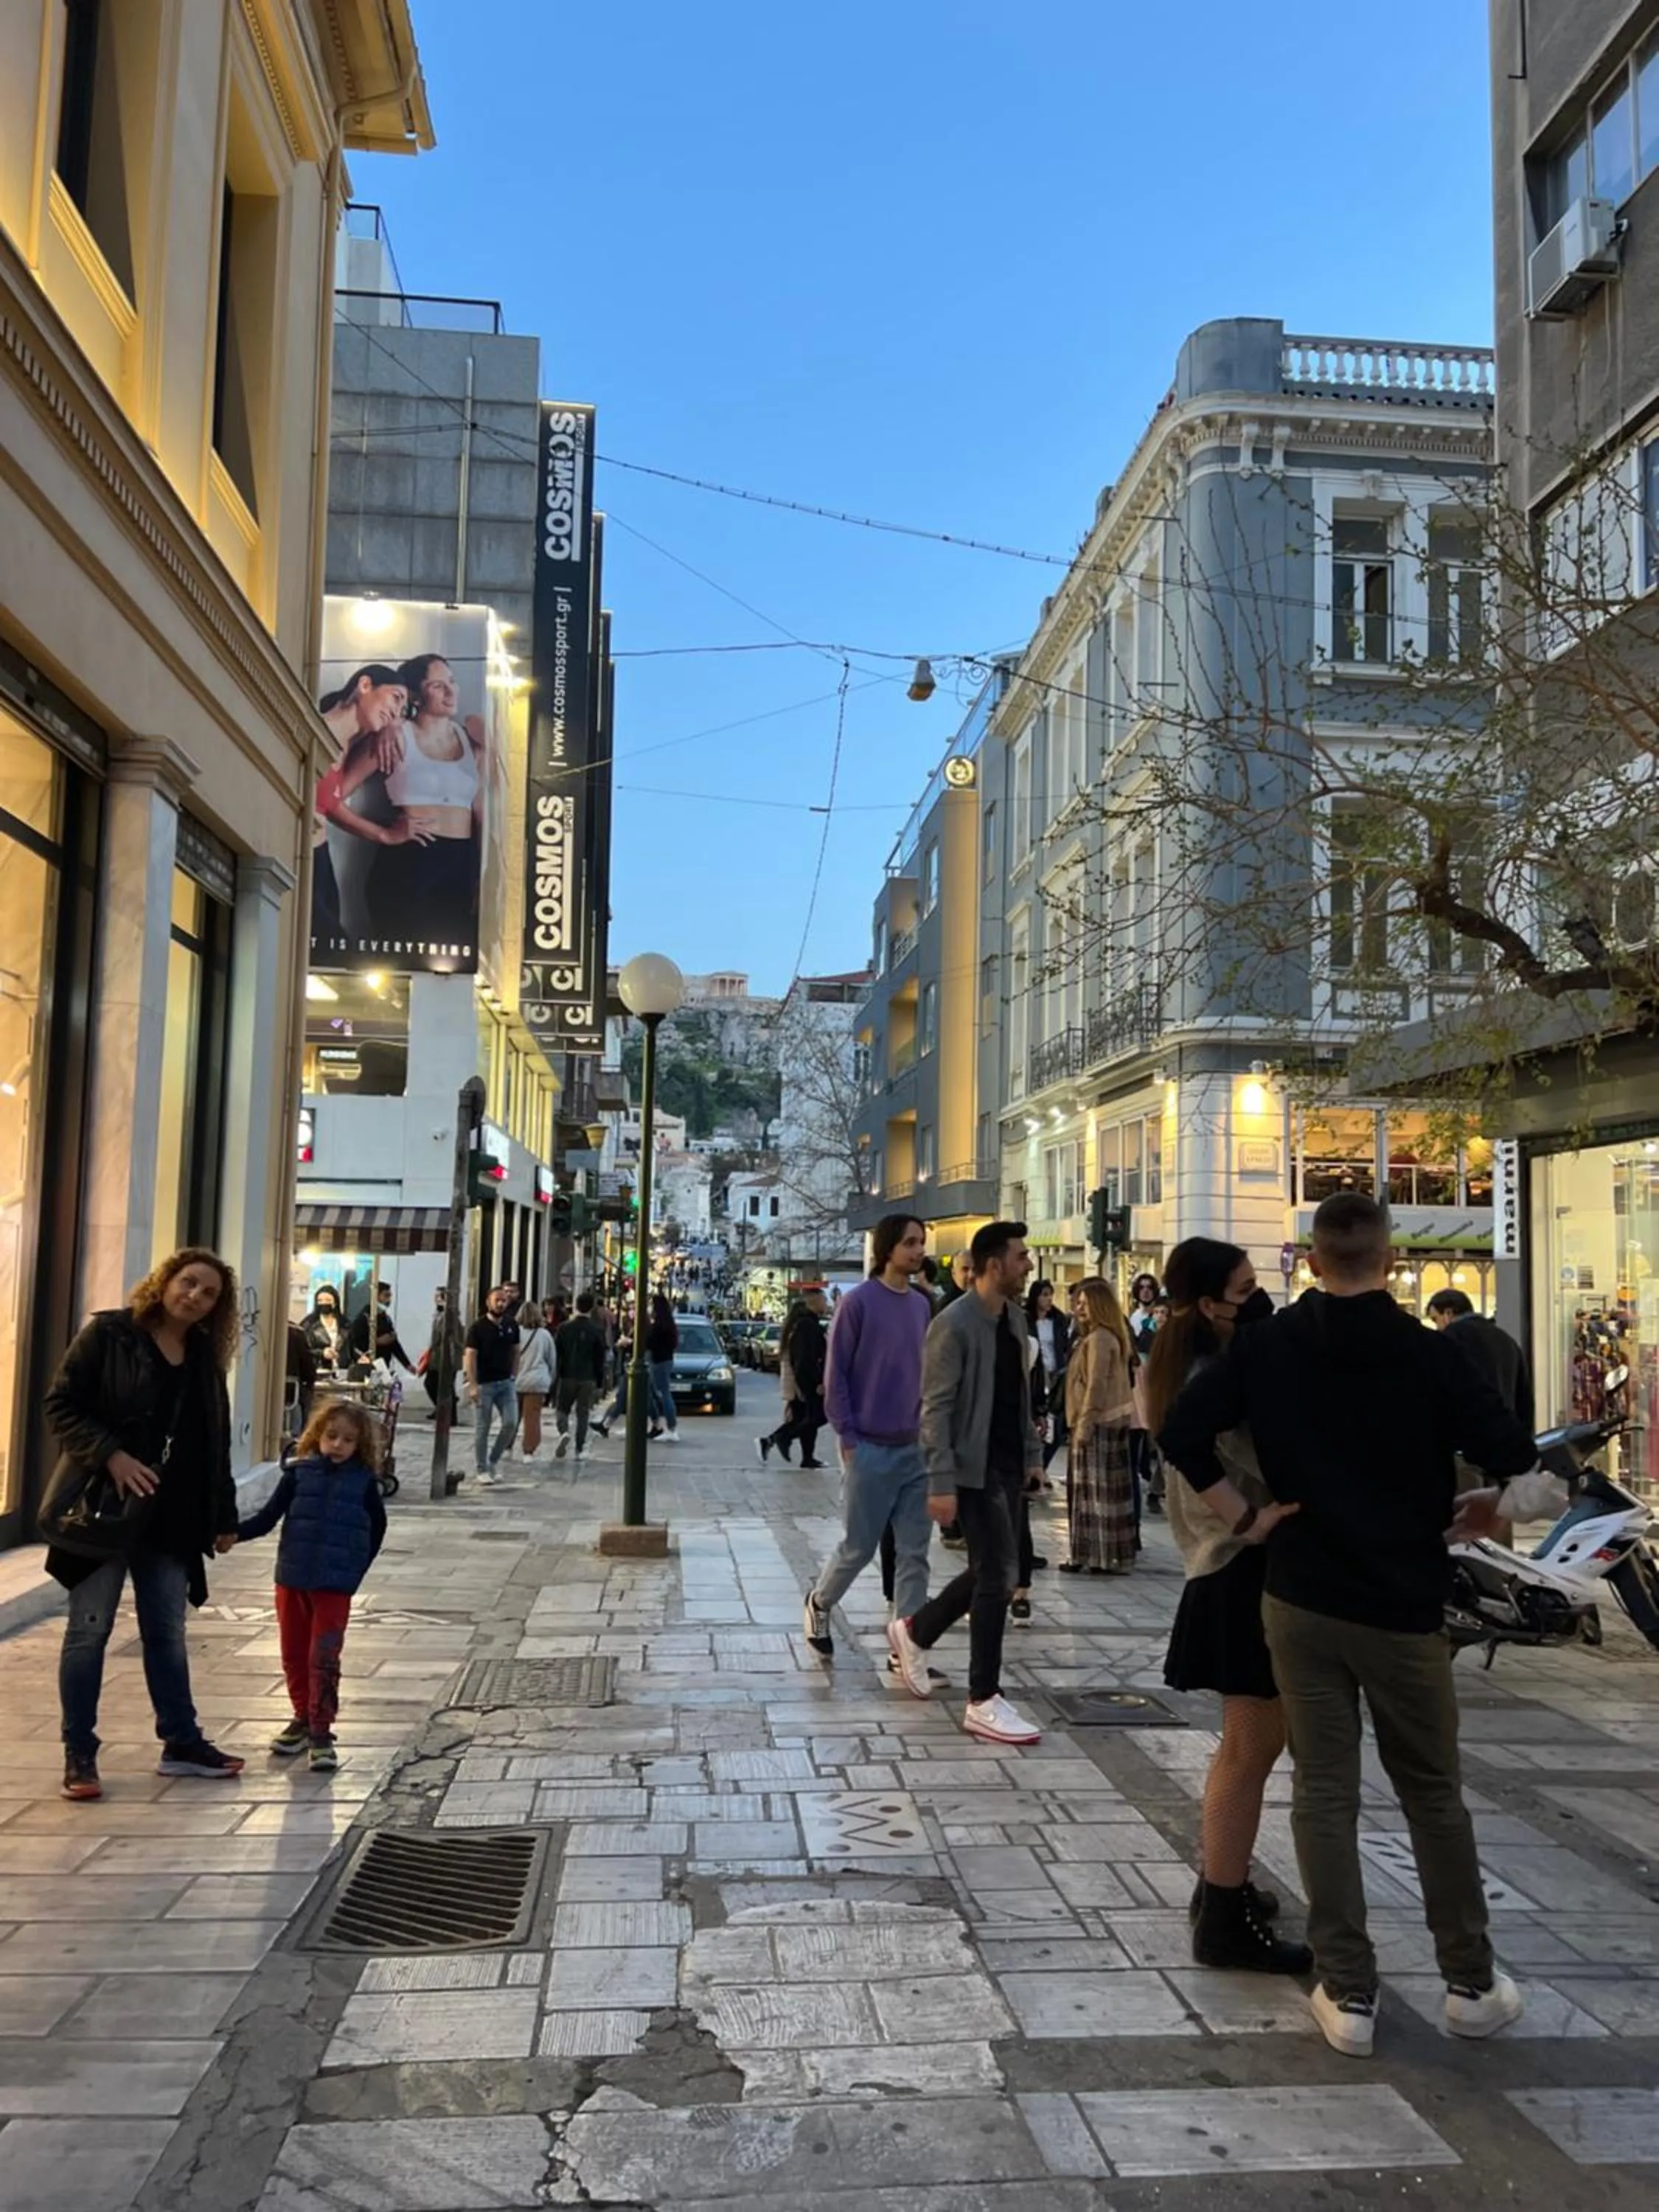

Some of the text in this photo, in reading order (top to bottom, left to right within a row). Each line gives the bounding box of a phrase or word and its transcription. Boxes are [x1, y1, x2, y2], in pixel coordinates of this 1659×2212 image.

[545, 411, 576, 561] COSMOS
[552, 596, 571, 757] www.cosmossport.gr
[330, 938, 346, 950] IS
[359, 939, 470, 957] EVERYTHING
[534, 796, 563, 950] COSMOS
